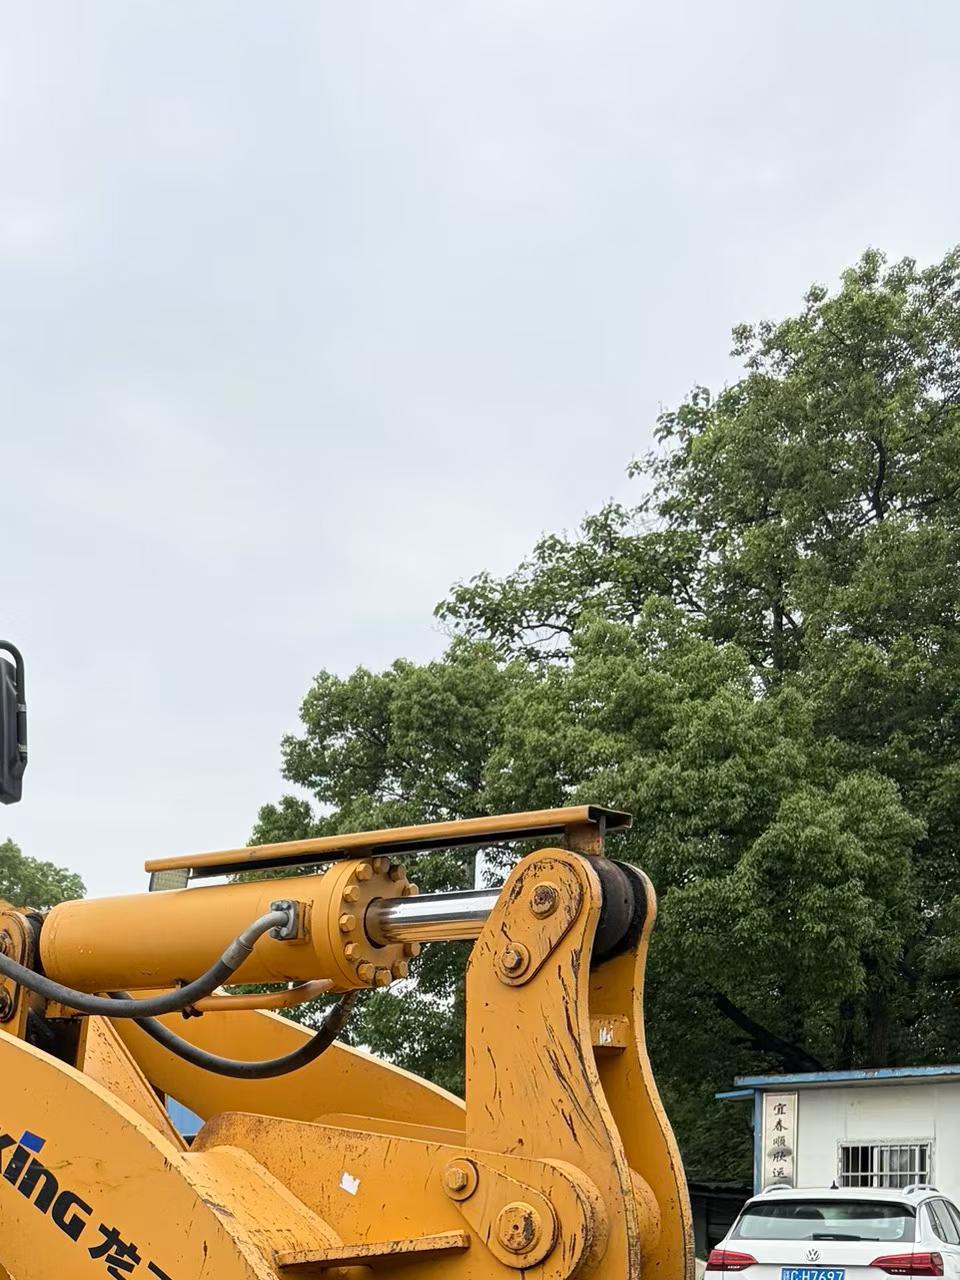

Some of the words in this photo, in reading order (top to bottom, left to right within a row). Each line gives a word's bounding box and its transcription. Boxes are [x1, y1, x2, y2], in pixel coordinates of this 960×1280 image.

[772, 1102, 789, 1184] 宜春顺欣运
